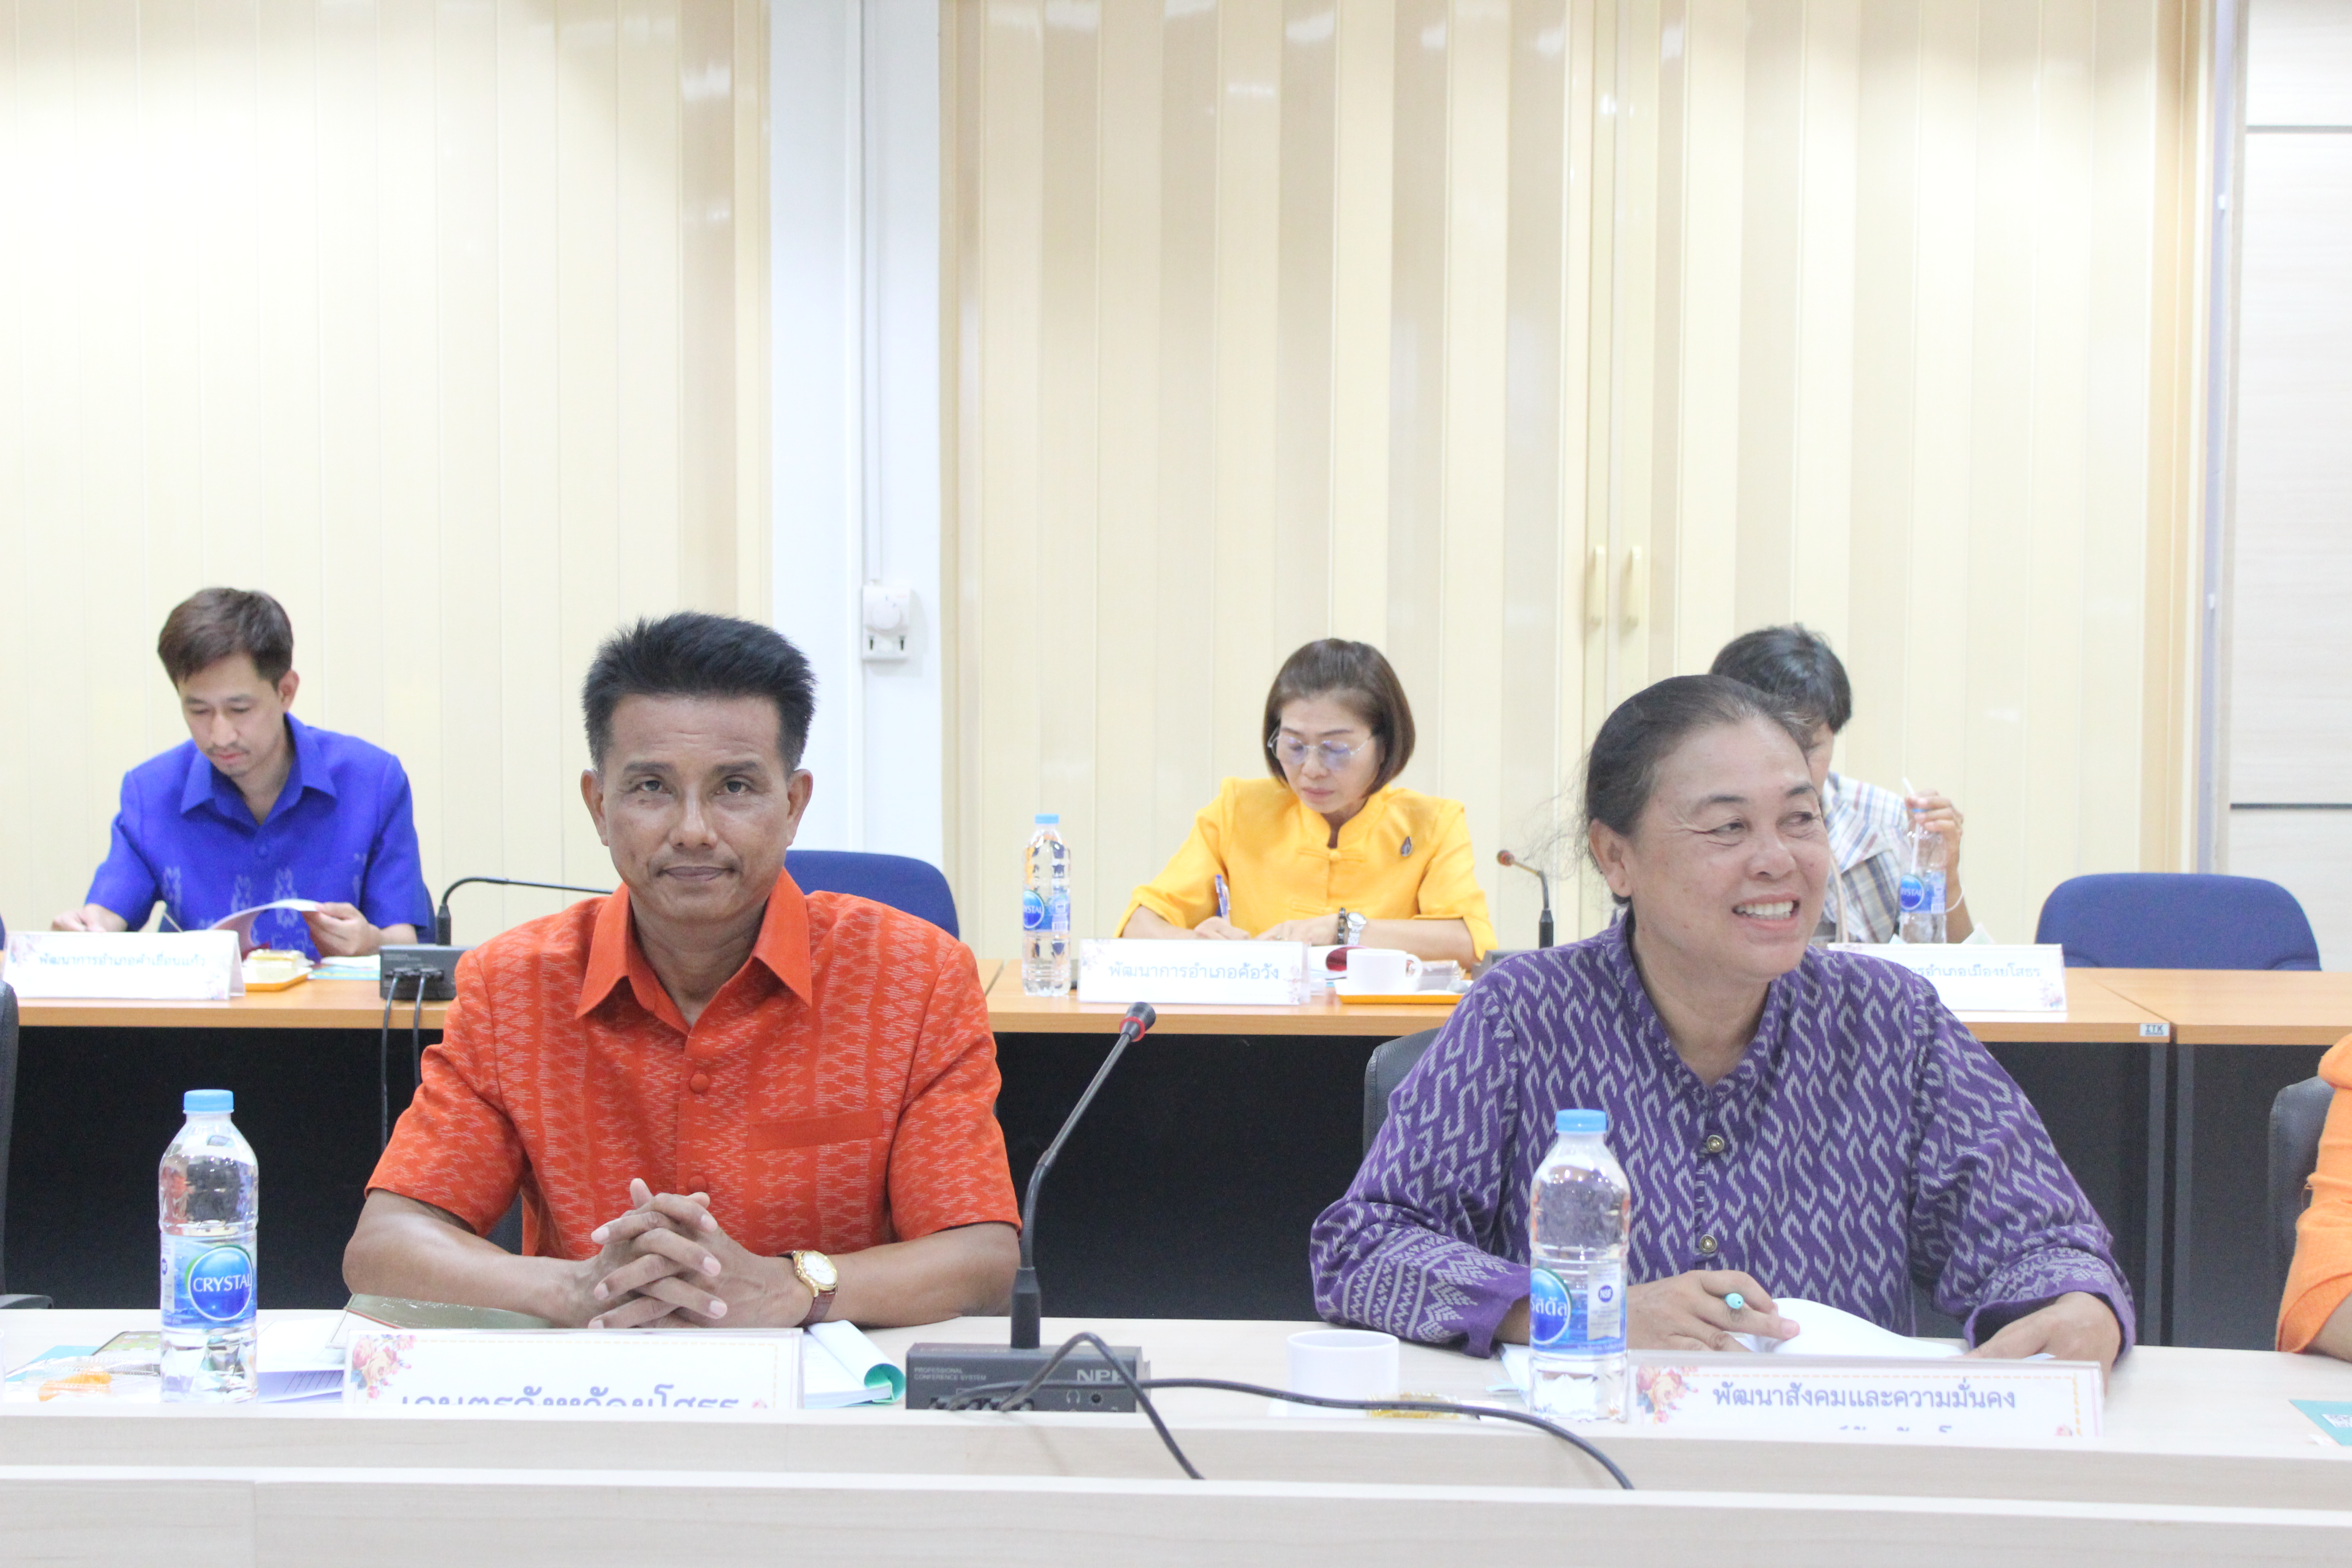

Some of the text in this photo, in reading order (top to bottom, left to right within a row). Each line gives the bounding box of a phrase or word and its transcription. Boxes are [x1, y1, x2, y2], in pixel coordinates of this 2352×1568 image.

[1108, 961, 1279, 980] พัฒนาการอำเภอค้อวัง
[193, 1274, 251, 1292] CRYSTAL
[1713, 1377, 2015, 1408] พัฒนาสังคมและความมั่นคง
